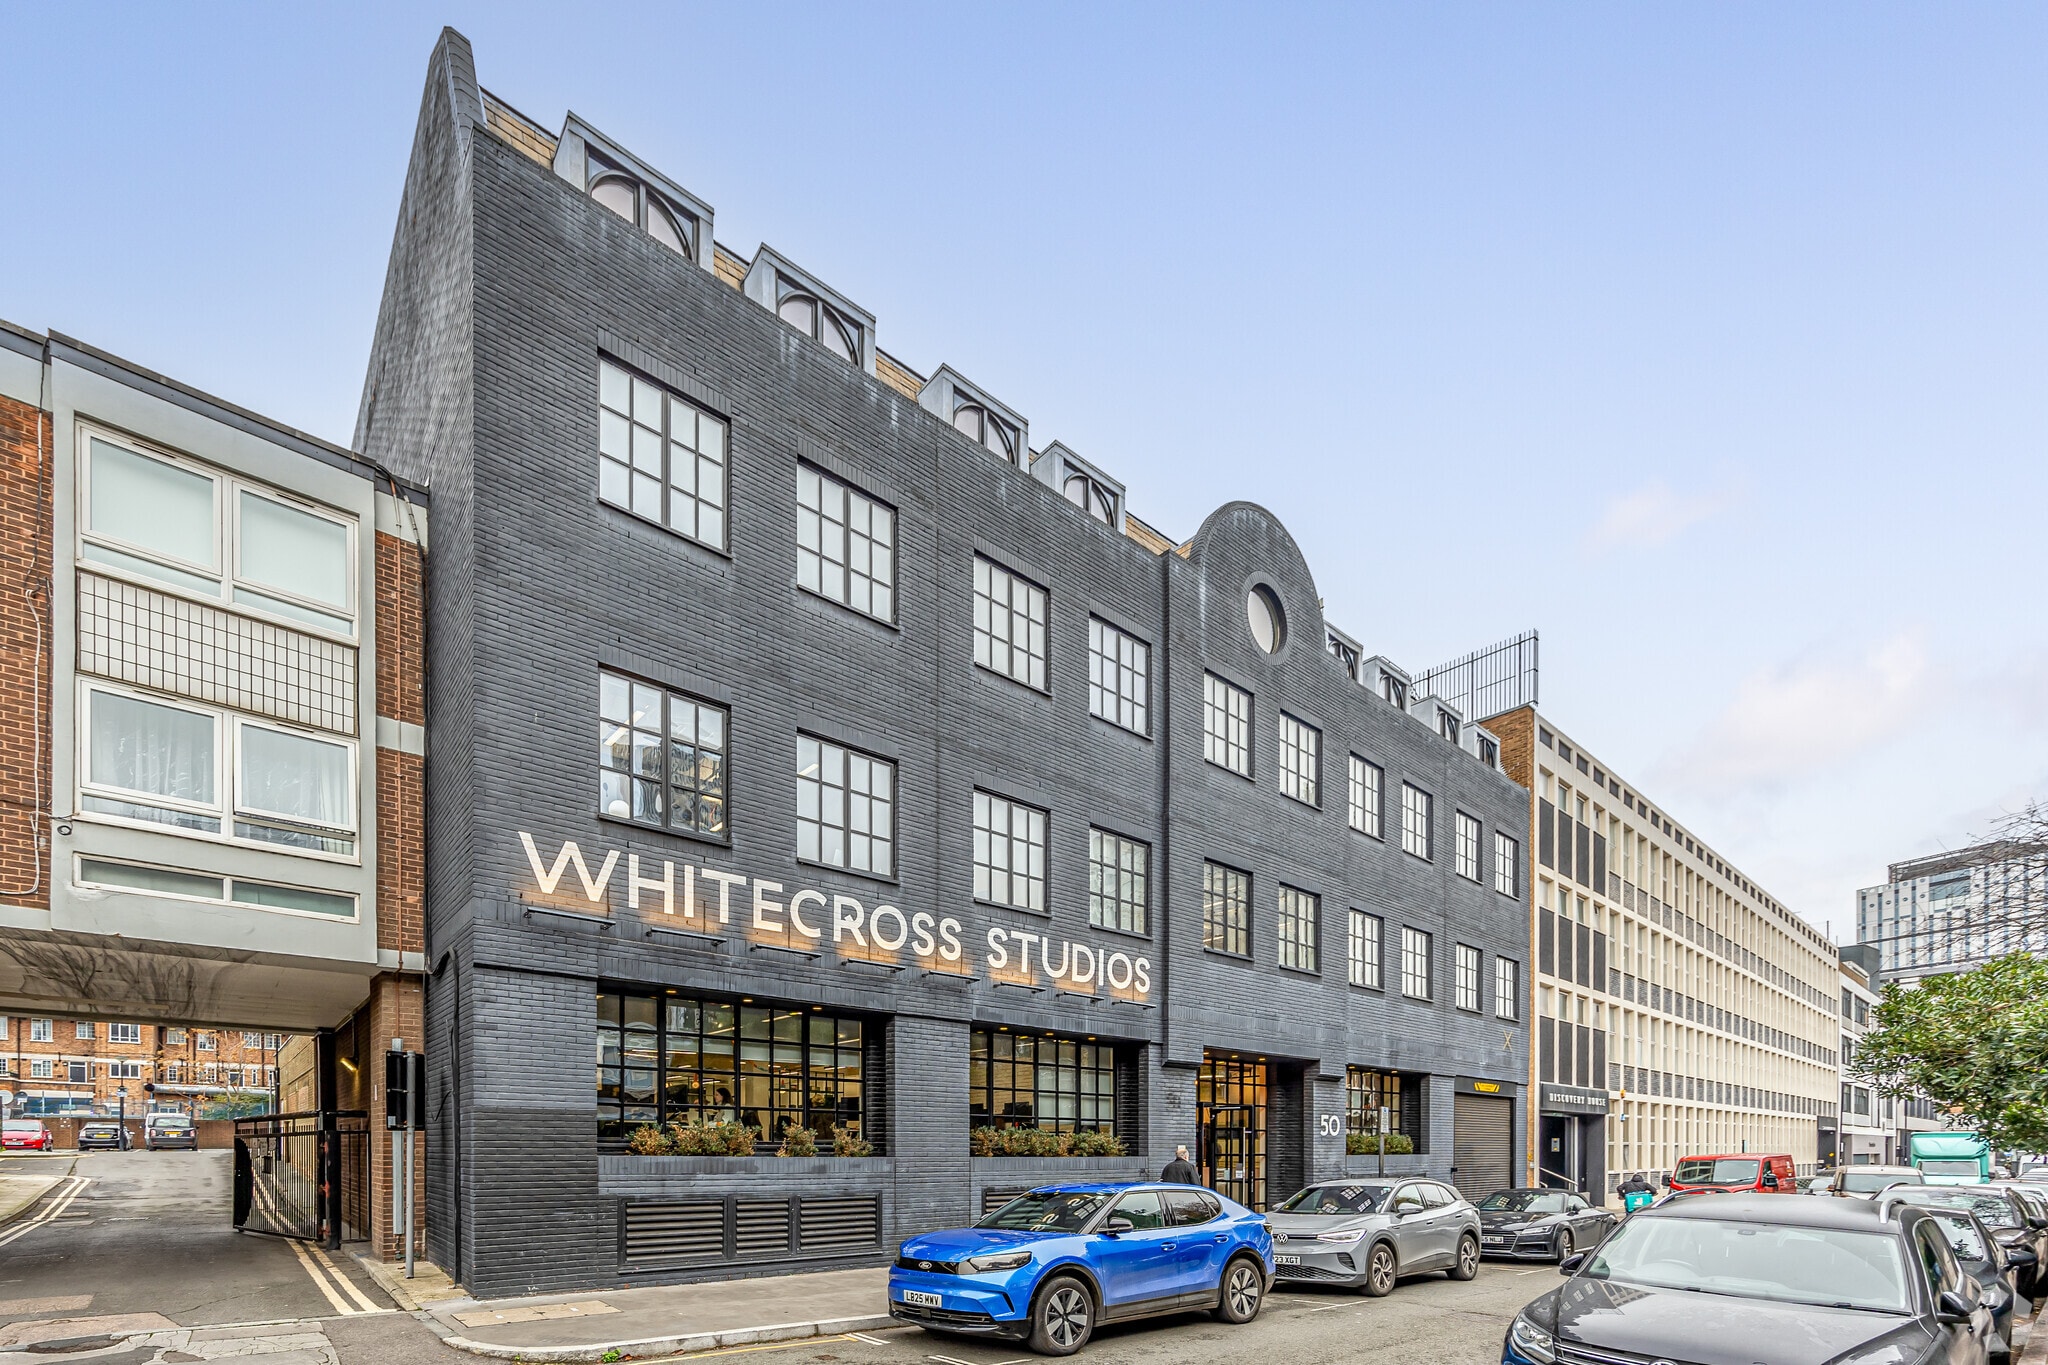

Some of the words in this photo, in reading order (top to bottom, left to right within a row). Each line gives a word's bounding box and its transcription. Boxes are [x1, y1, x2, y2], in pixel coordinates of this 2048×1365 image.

[518, 831, 962, 961] WHITECROSS
[987, 927, 1150, 993] STUDIOS
[1549, 1093, 1585, 1104] DISCOVERY
[1587, 1097, 1606, 1107] HOUSE
[1320, 1114, 1340, 1136] 50
[1284, 1256, 1299, 1264] XGT
[906, 1291, 923, 1304] LB25
